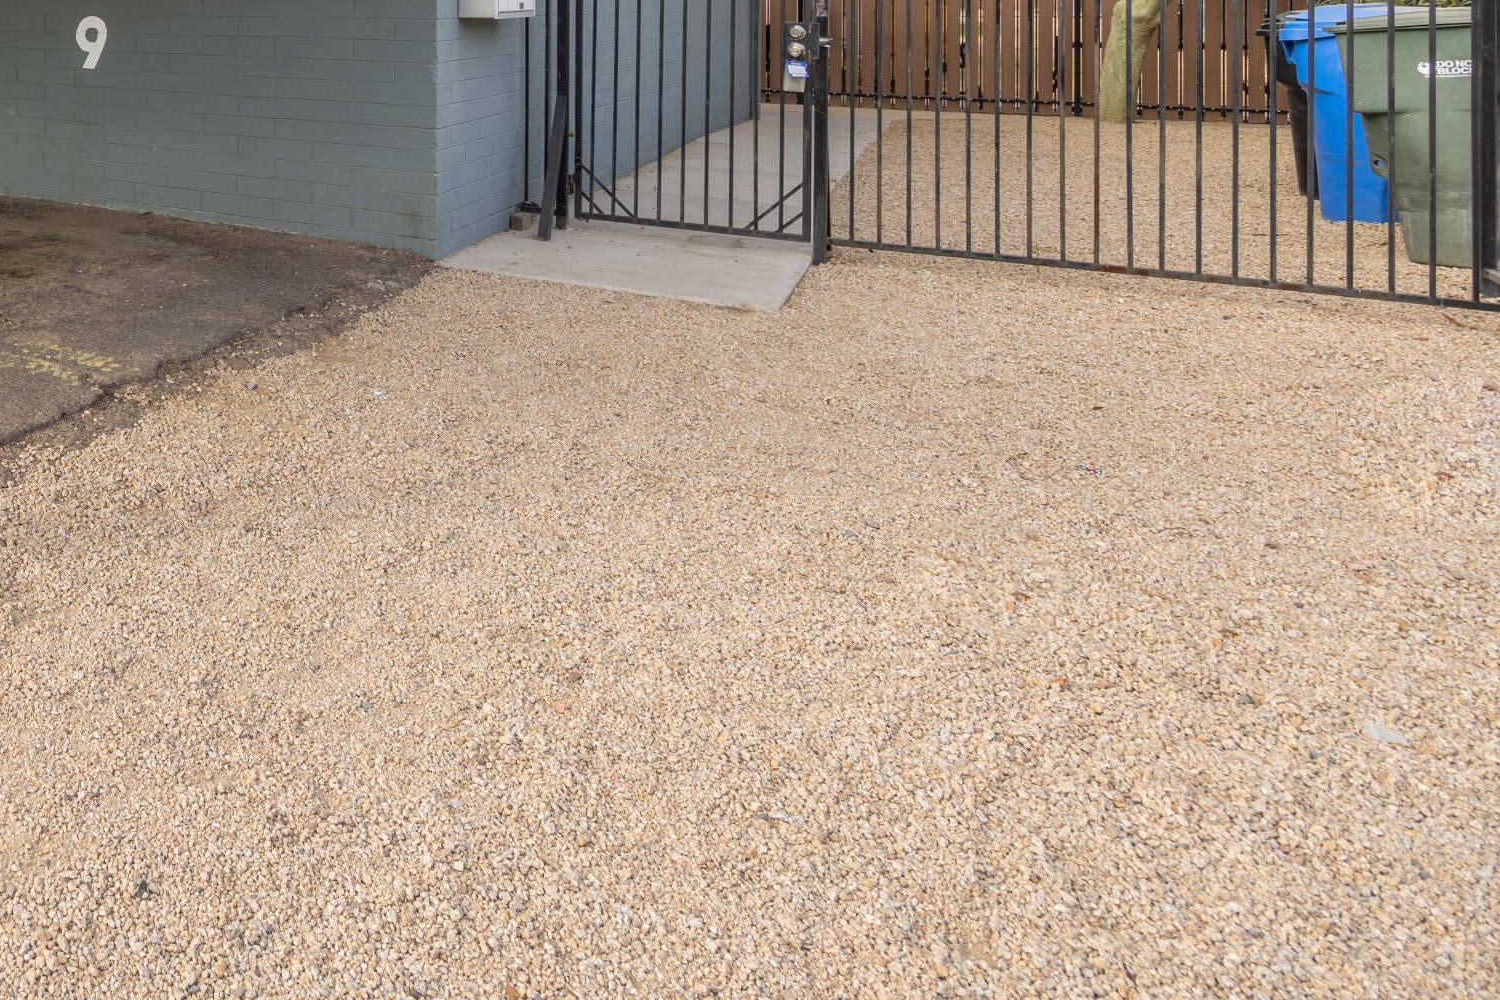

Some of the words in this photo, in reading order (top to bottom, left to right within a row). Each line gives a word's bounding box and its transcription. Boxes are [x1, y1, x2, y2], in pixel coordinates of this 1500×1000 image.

[75, 15, 108, 69] 9
[1436, 60, 1454, 68] DO
[1455, 60, 1472, 68] NO
